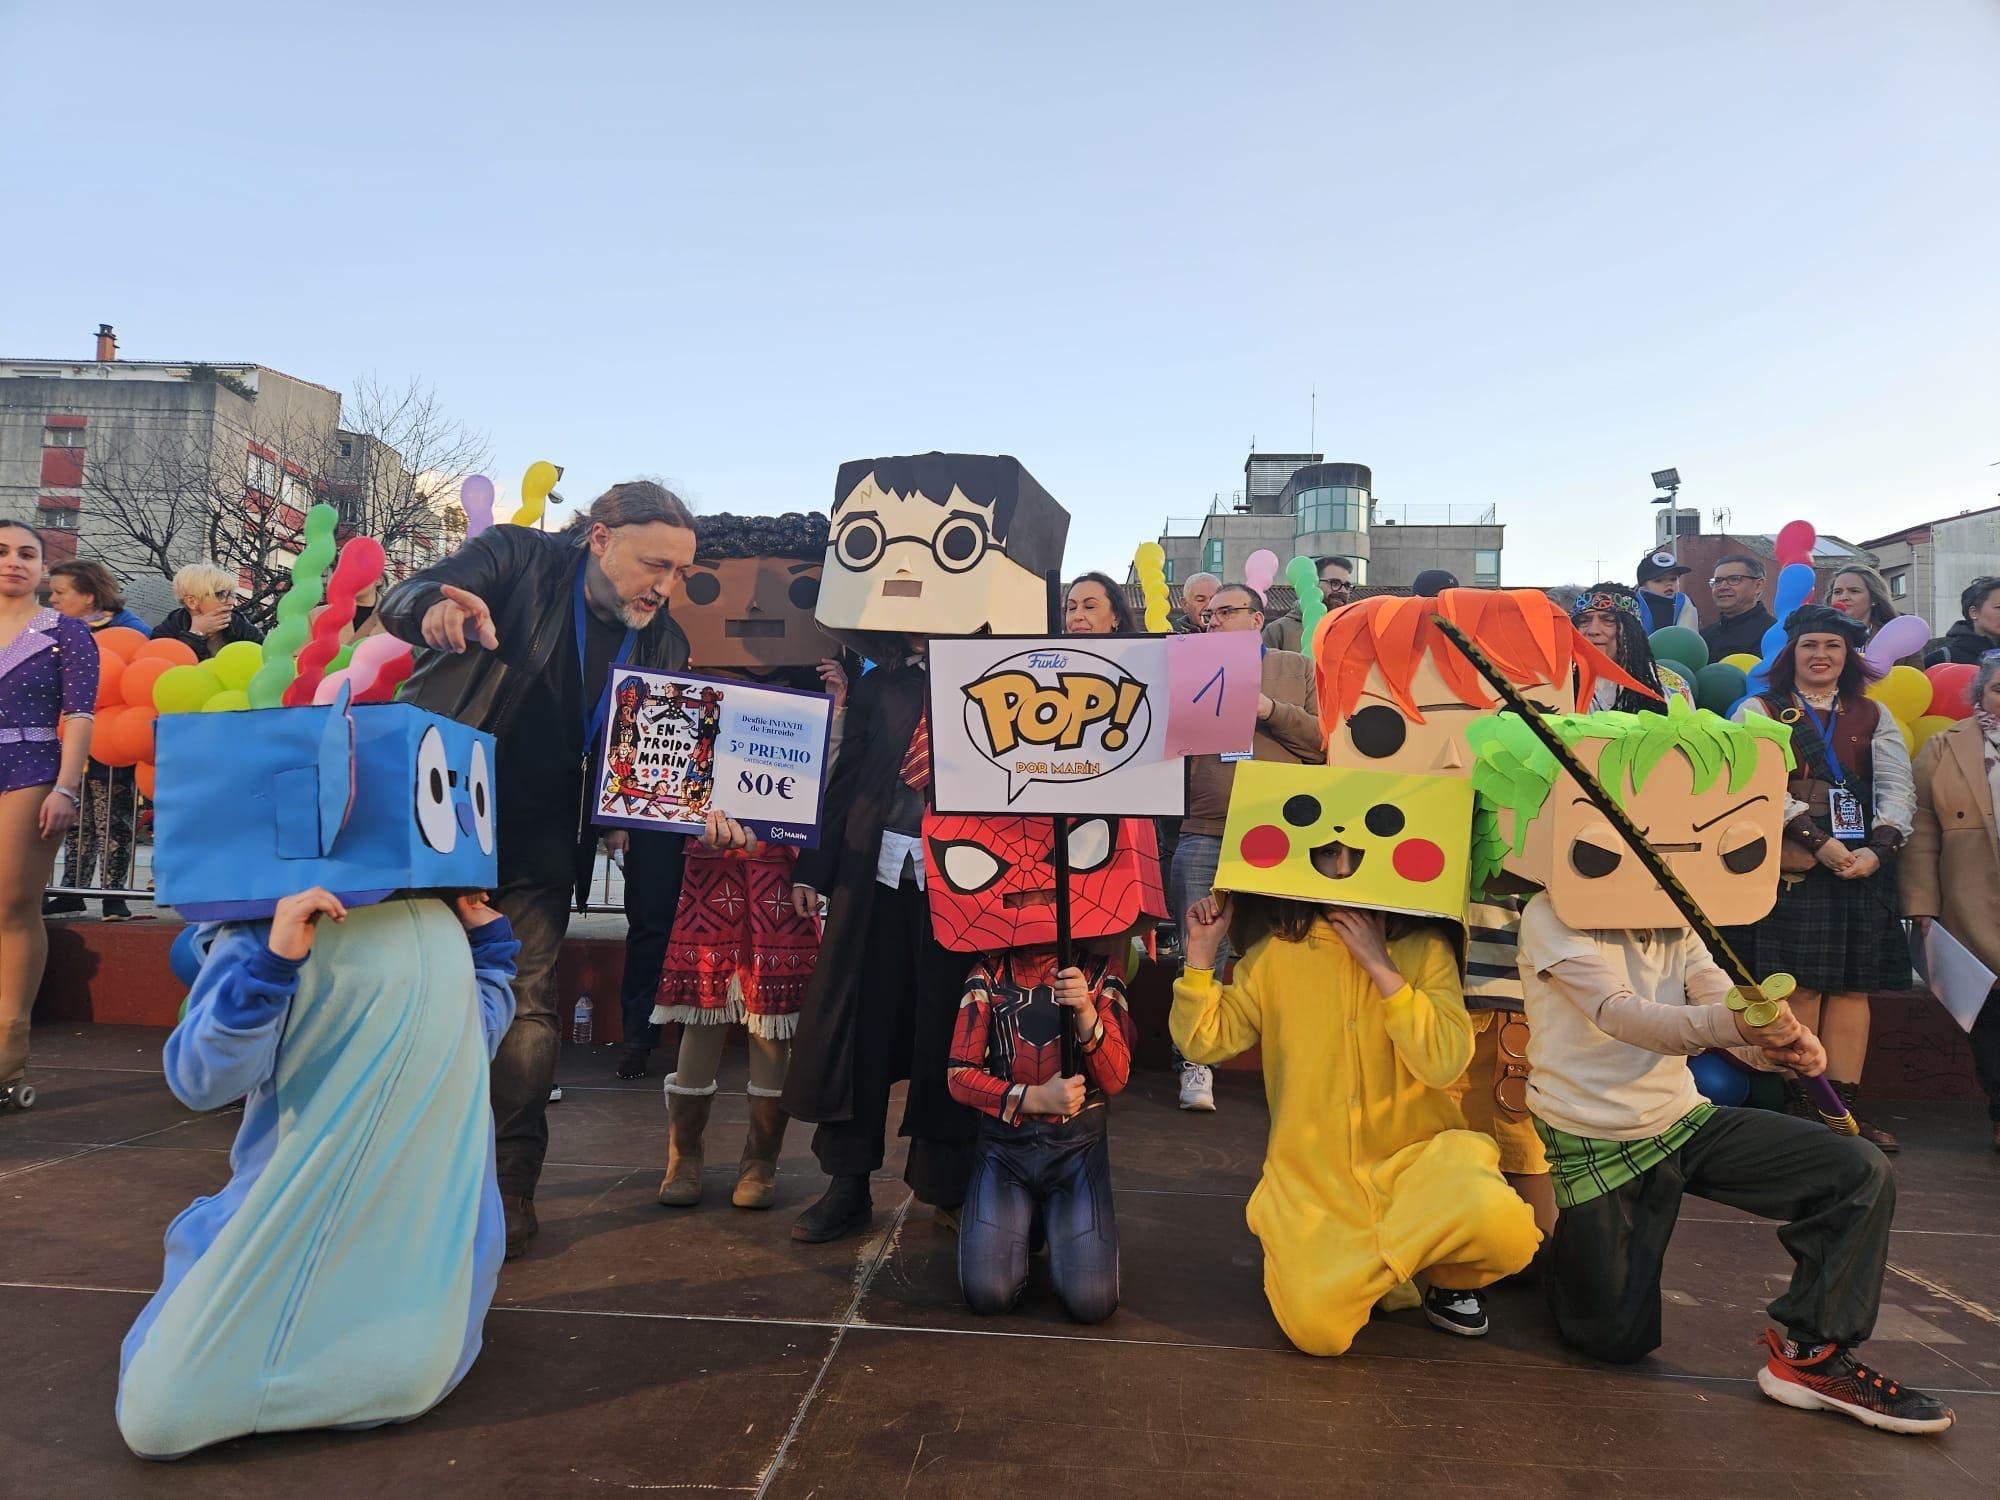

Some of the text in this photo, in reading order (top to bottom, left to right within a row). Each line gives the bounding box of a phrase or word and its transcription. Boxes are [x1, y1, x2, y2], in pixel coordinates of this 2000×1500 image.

[1027, 653, 1068, 668] Funko
[656, 723, 681, 737] EN-
[742, 715, 805, 731] Desfile INFANTIL
[762, 726, 795, 737] Entroido
[643, 737, 692, 752] TROIDO
[638, 752, 688, 768] MARÍN
[749, 742, 811, 764] PREMIO
[641, 768, 679, 782] 2025
[1016, 760, 1100, 775] POR MARÍN
[737, 770, 796, 800] 80€
[784, 831, 807, 841] MARÍN
